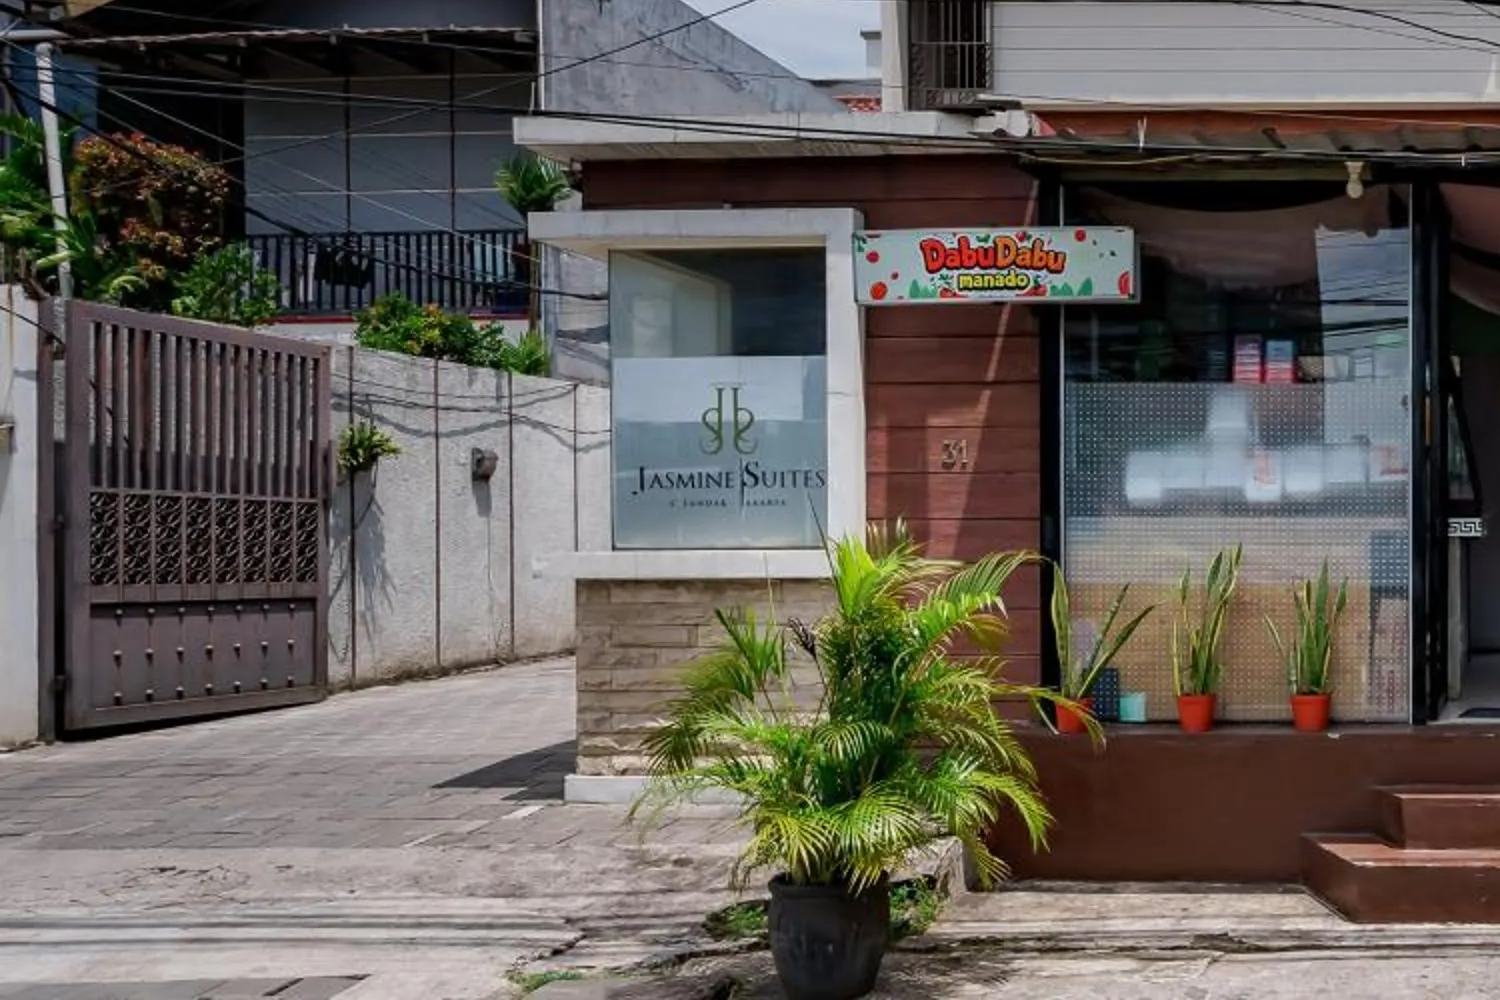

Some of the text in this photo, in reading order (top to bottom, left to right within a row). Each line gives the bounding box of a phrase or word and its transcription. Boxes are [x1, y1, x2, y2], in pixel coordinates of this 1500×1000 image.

[919, 234, 1067, 274] DabuDabu
[956, 269, 1030, 291] manado
[942, 439, 969, 464] 31
[631, 460, 827, 495] JASMINE SUITES
